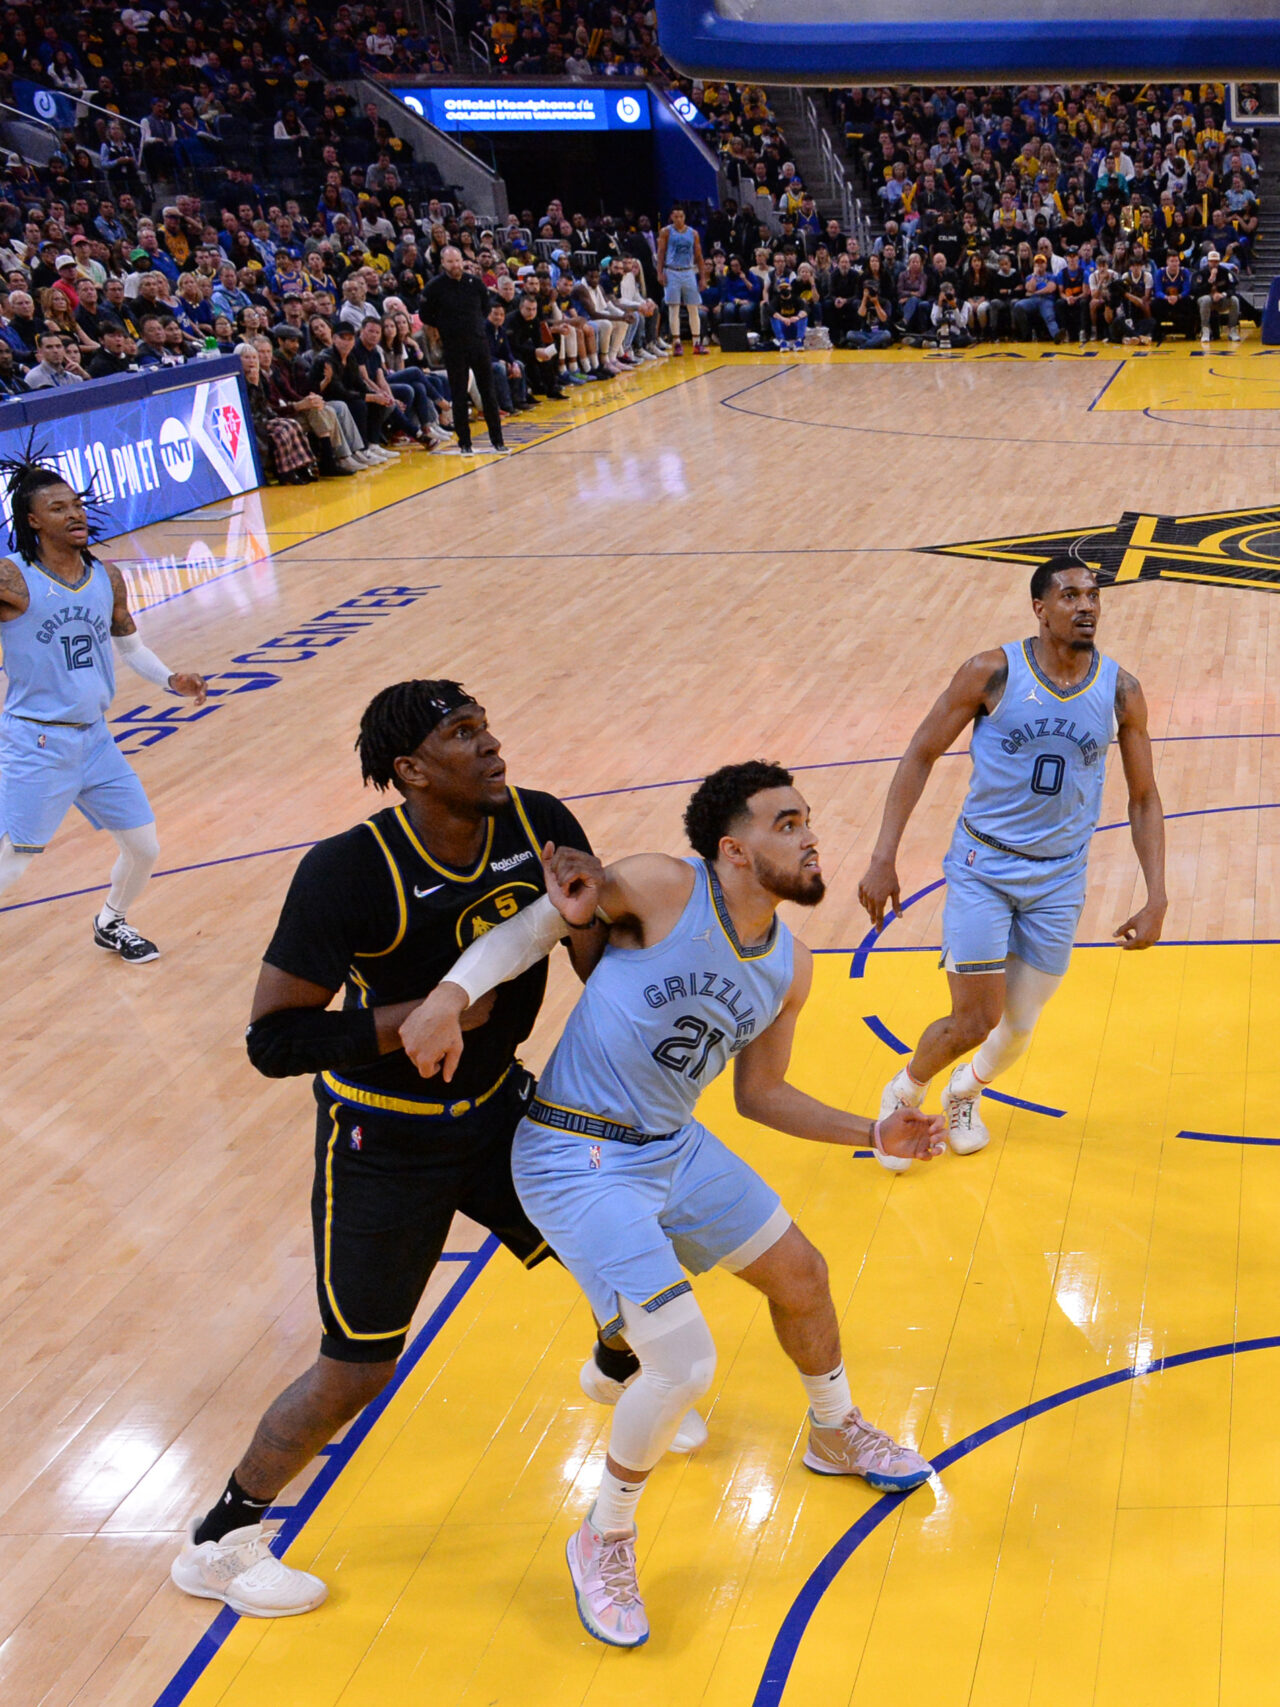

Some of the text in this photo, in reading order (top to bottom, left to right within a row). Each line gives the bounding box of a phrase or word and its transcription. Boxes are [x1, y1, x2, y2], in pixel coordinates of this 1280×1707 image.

[444, 99, 494, 110] Official
[496, 99, 576, 112] Headphone
[445, 111, 596, 121] GOLDEN STATE WARRIORS
[922, 351, 1099, 360] SAN
[84, 441, 116, 506] 10
[111, 444, 143, 499] PM
[136, 439, 161, 491] ET
[35, 606, 109, 645] GRIZZLIES
[230, 584, 443, 664] CENTER
[60, 634, 94, 671] 12
[1001, 717, 1099, 767] GRIZZLIES
[1030, 753, 1066, 797] 0
[490, 849, 534, 873] Rakuten
[494, 892, 519, 919] 5
[643, 971, 756, 1053] GRIZZLIES
[651, 1014, 726, 1081] 21
